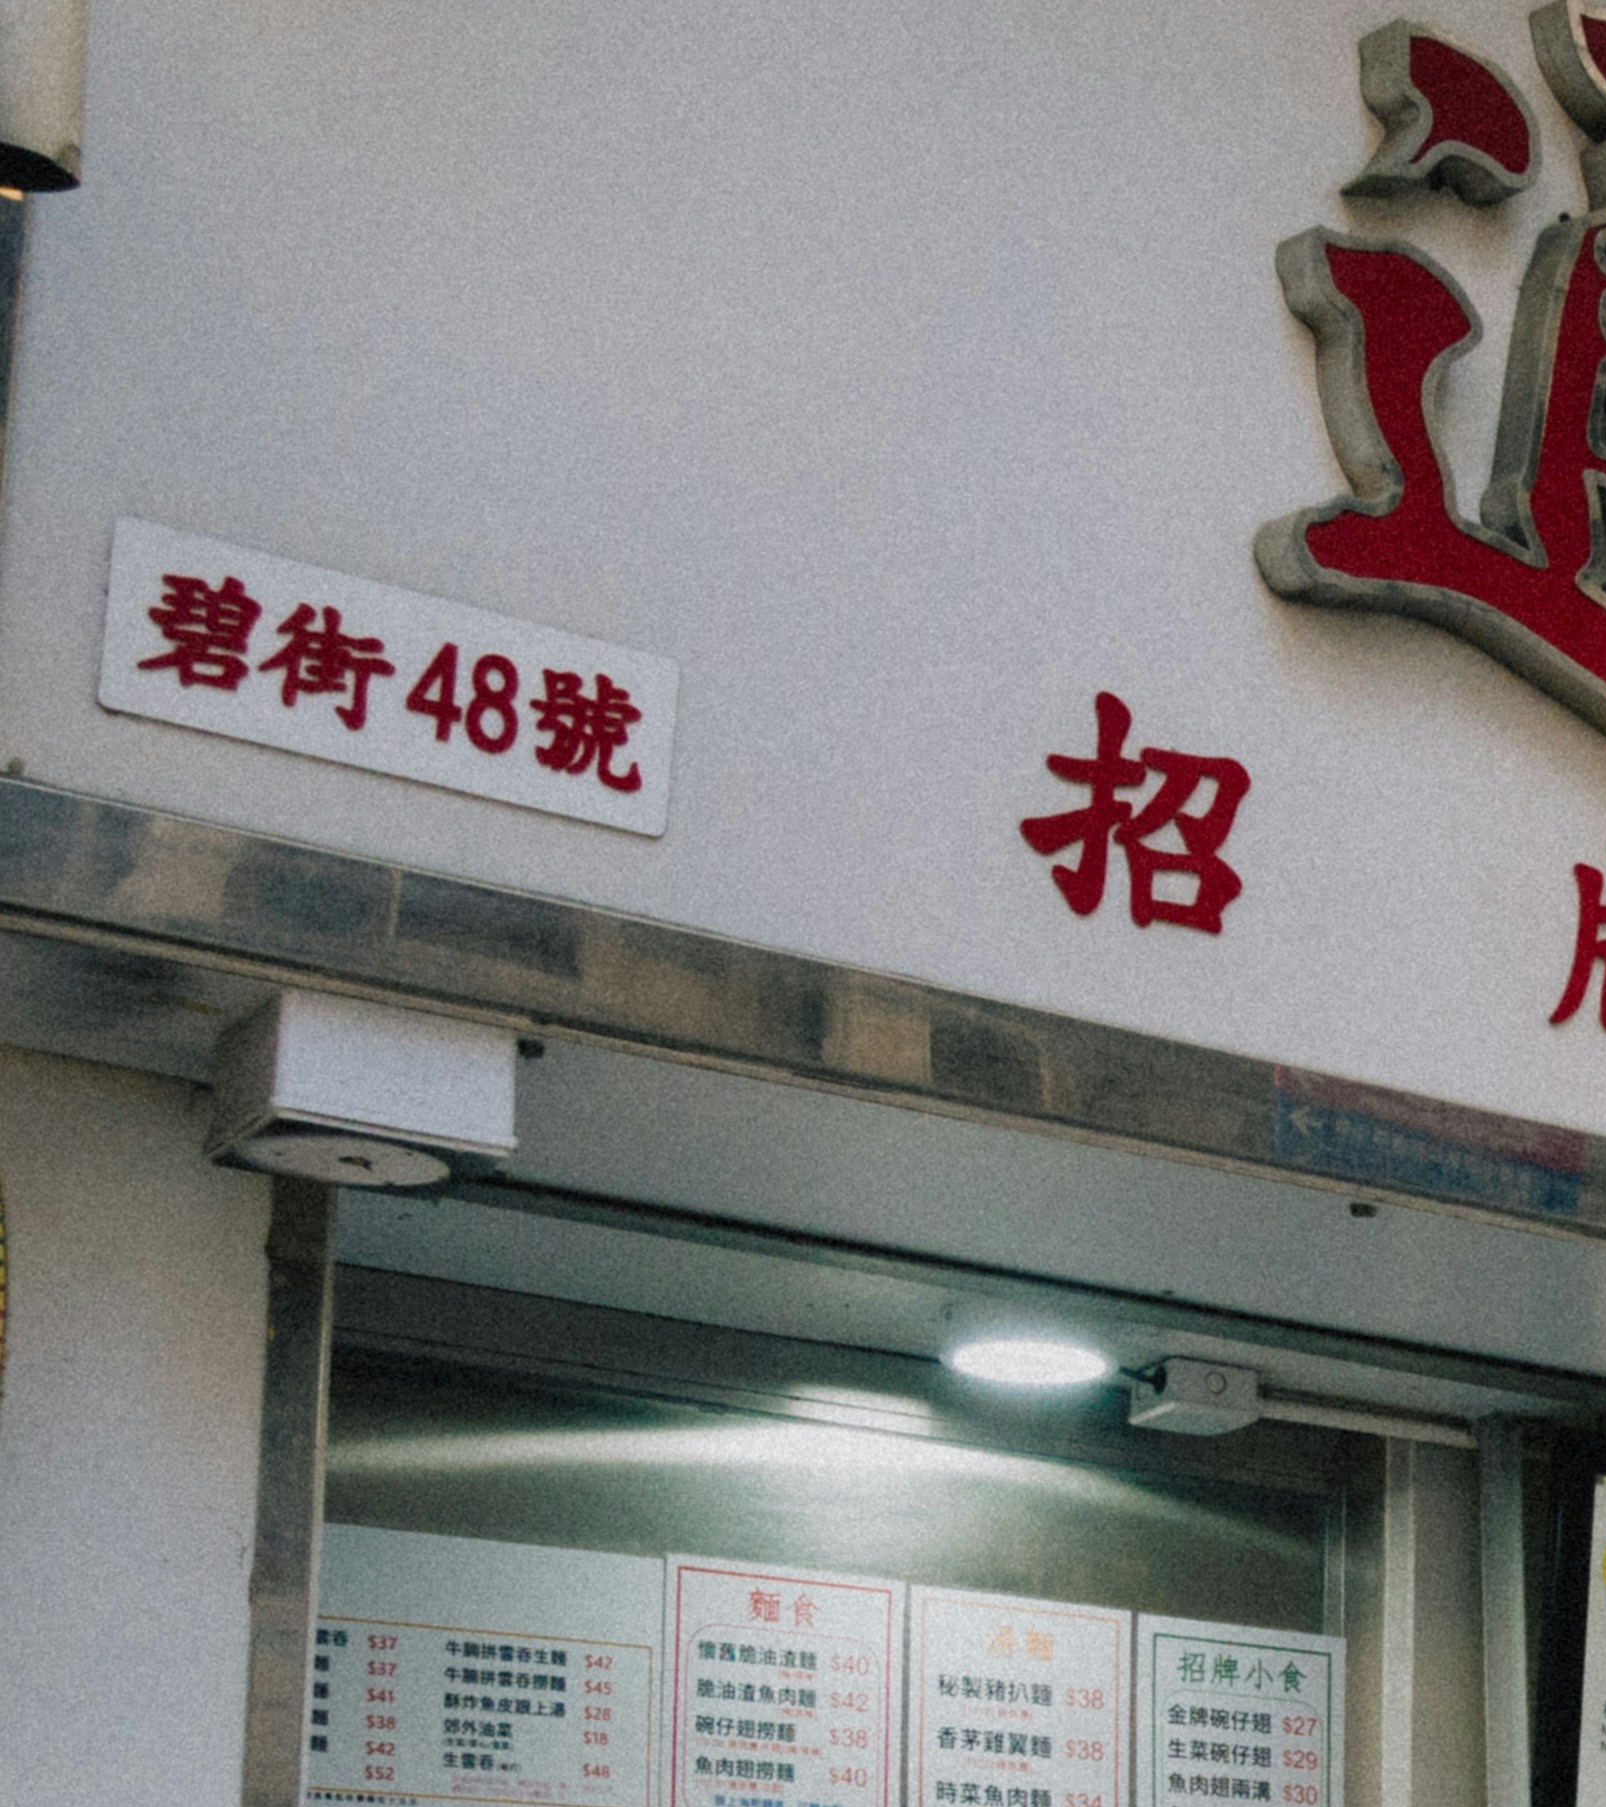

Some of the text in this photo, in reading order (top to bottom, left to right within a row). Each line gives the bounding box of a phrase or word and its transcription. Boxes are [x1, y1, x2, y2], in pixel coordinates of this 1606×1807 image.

[138, 574, 642, 793] 碧街48號
[748, 1588, 822, 1628] 麵食
[368, 1634, 397, 1652] $37
[367, 1660, 397, 1677] $37
[584, 1654, 614, 1671] $42
[830, 1653, 870, 1677] $40
[1176, 1652, 1308, 1694] 招牌小食
[366, 1687, 396, 1704] $41
[584, 1679, 613, 1696] $45
[937, 1673, 1105, 1710] 秘製豬扒麵 $38
[829, 1691, 869, 1713] $42
[366, 1714, 396, 1731] $38
[583, 1706, 612, 1723] $28
[1167, 1703, 1319, 1737] 金牌碗仔翅 $27
[583, 1730, 609, 1746] $18
[695, 1714, 797, 1743] 碗仔翅撈麵
[829, 1728, 869, 1750] $38
[365, 1740, 396, 1757] $42
[936, 1726, 1105, 1762] 香茅雞翼麵 $38
[1167, 1738, 1319, 1771] 生菜碗仔翅 $29
[364, 1765, 395, 1782] $52
[582, 1763, 612, 1779] $48
[695, 1755, 868, 1788] 魚肉翅撈麵 $40
[1282, 1784, 1319, 1806] $30
